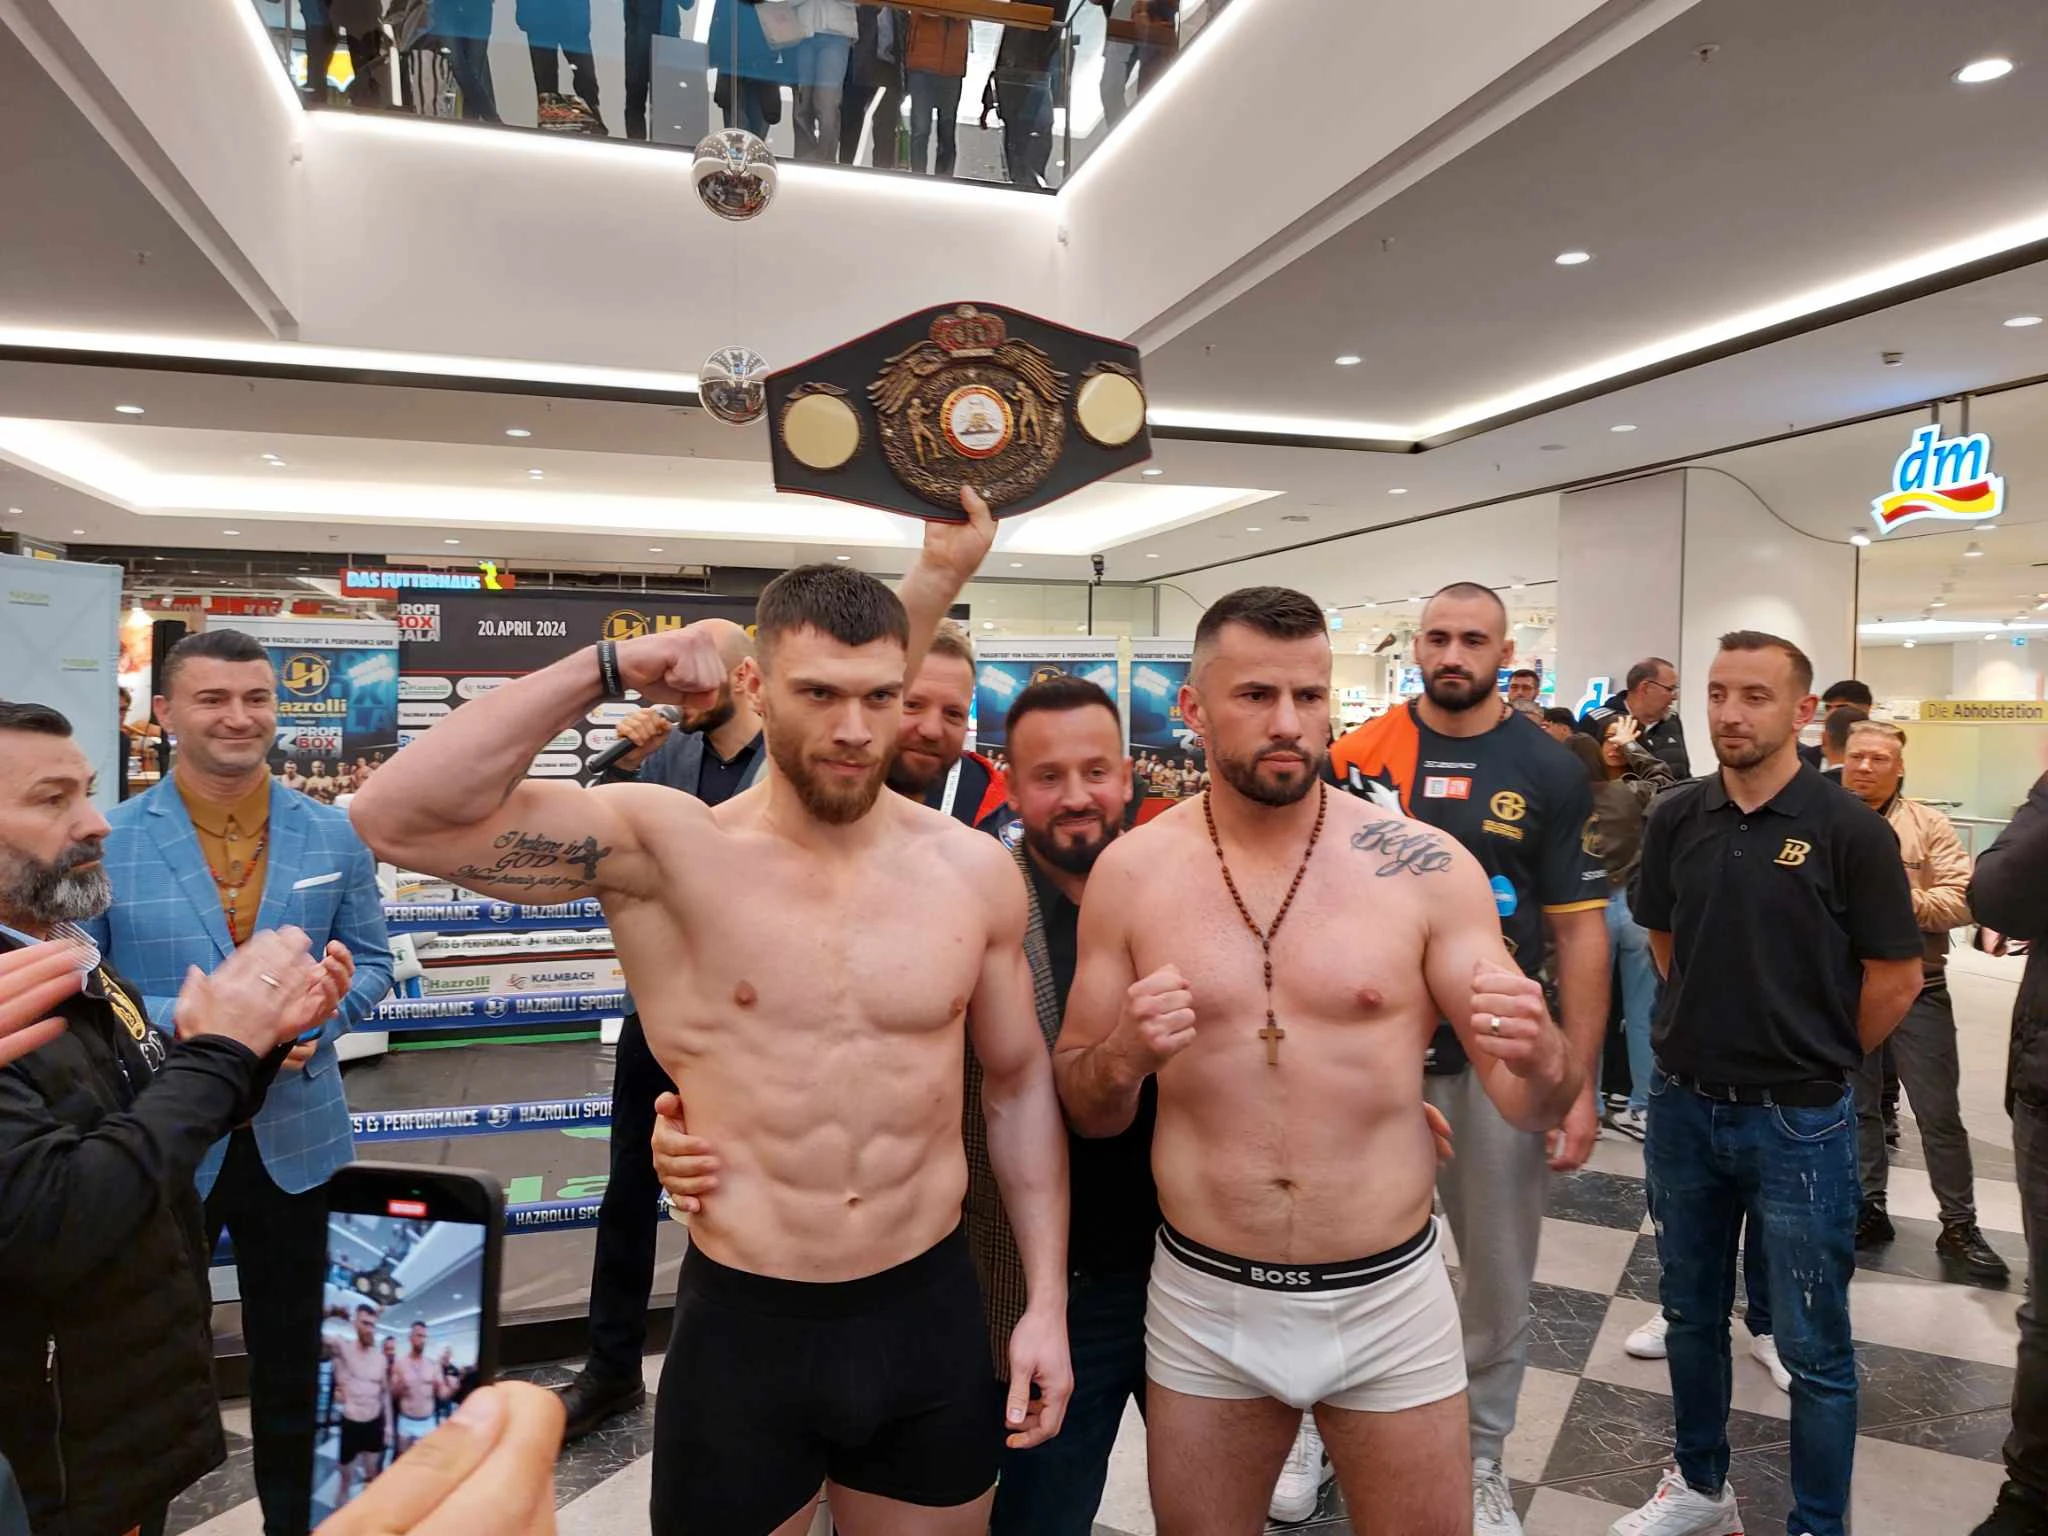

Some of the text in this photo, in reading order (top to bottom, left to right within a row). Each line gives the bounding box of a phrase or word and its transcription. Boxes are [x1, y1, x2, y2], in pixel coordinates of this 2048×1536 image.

[1900, 430, 1984, 493] dm
[346, 571, 481, 590] DAS FUTTERHAUS
[398, 603, 440, 616] ROFI
[536, 621, 567, 636] 2024
[279, 699, 347, 713] azrolli
[1928, 703, 2043, 719] Die Abholstation
[297, 727, 342, 738] PROFI
[299, 737, 336, 749] BOX
[384, 905, 481, 921] PERFORMANCE
[520, 902, 581, 919] HAZROLLI
[430, 976, 490, 989] Hazrolli
[531, 971, 595, 983] KALMBACH
[379, 1000, 475, 1020] PERFORMANCE
[515, 996, 577, 1014] HAZROLLI
[366, 1114, 380, 1132] &
[383, 1109, 479, 1131] PERFORMANCE
[519, 1103, 580, 1122] HAZROLLI
[515, 1207, 576, 1226] HAZROLLI
[1250, 1267, 1312, 1286] BOSS
